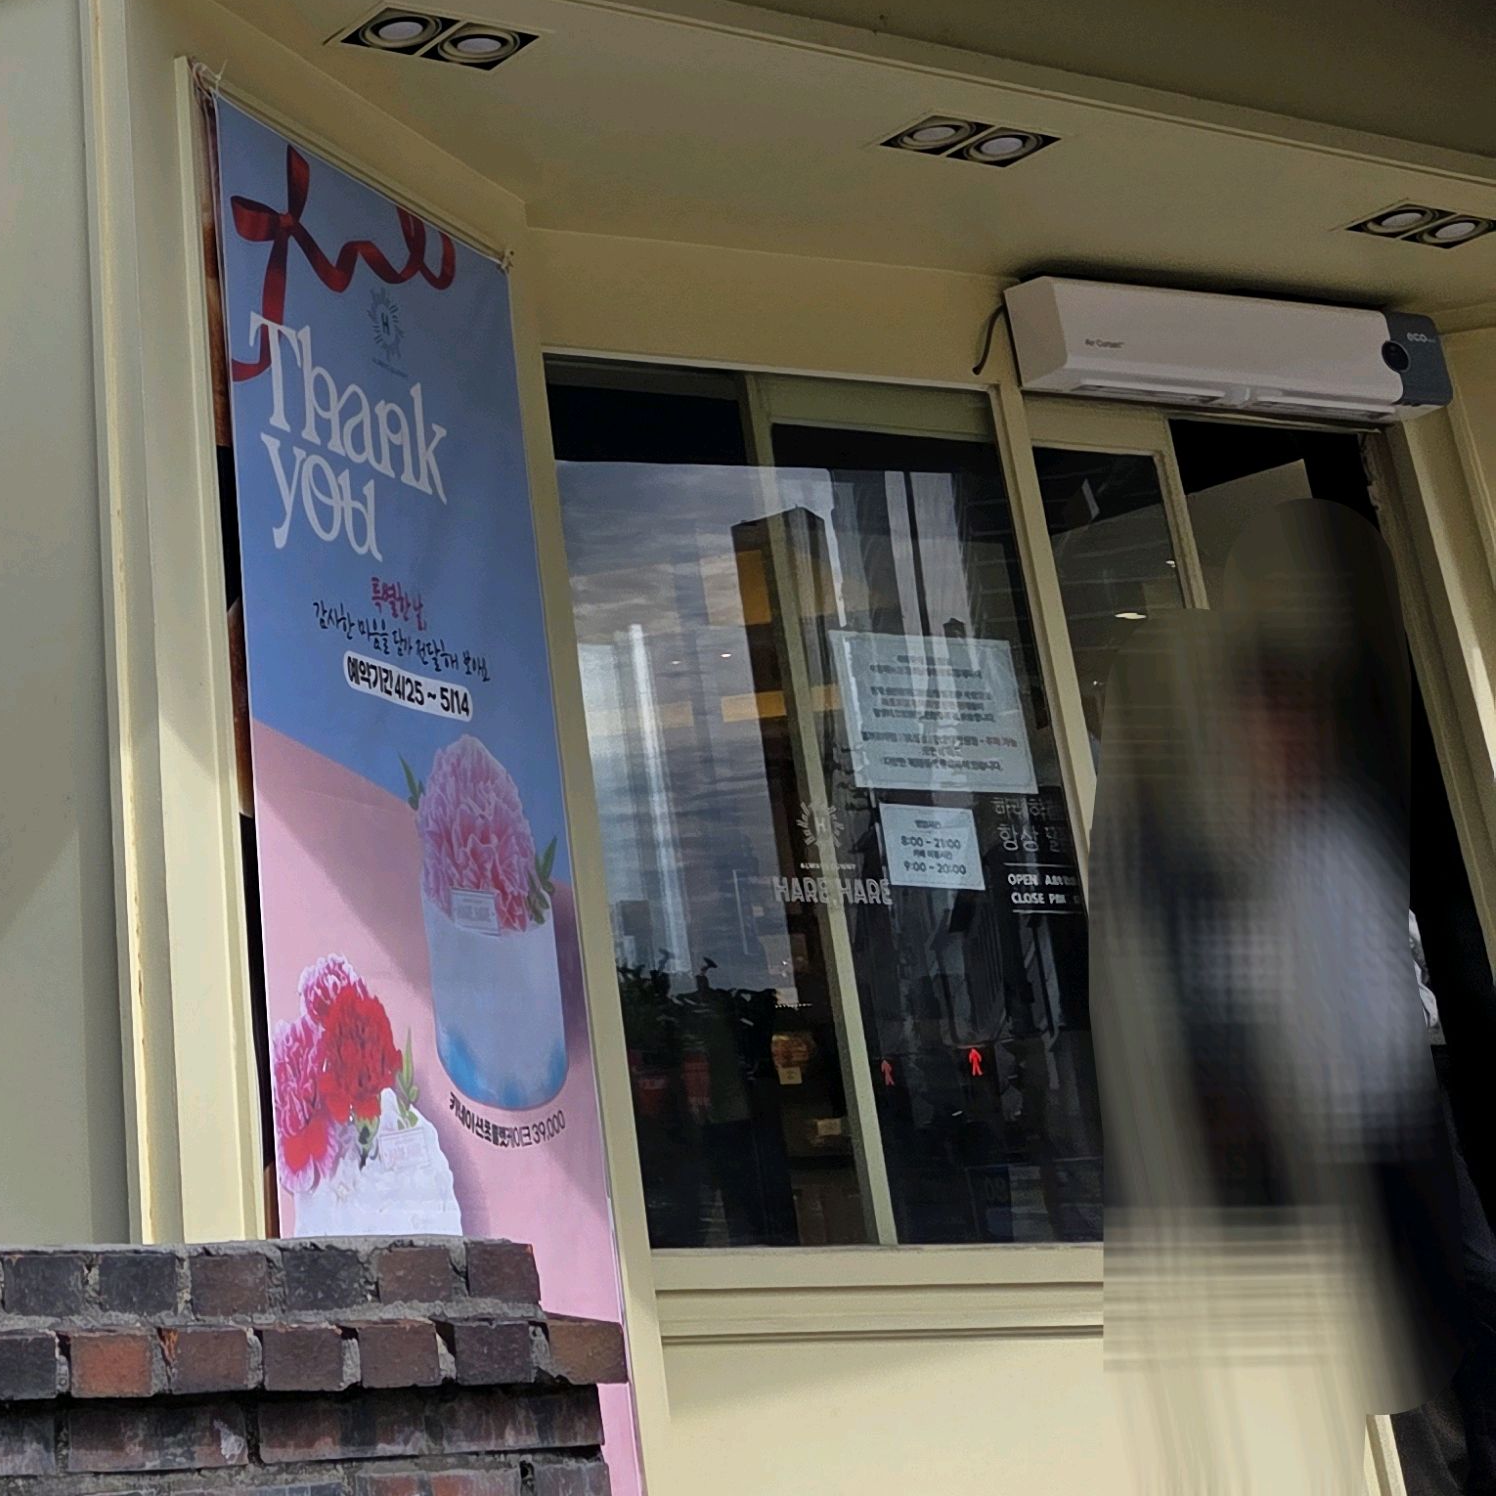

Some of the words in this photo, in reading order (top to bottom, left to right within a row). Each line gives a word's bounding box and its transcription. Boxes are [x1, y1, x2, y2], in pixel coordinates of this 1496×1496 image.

[248, 310, 448, 505] Thank
[260, 432, 383, 562] you
[313, 600, 355, 640] 감사한
[358, 617, 390, 655] 마음을
[415, 638, 460, 673] 전달해
[1007, 873, 1039, 886] OPEN
[1010, 891, 1046, 905] CLOSE
